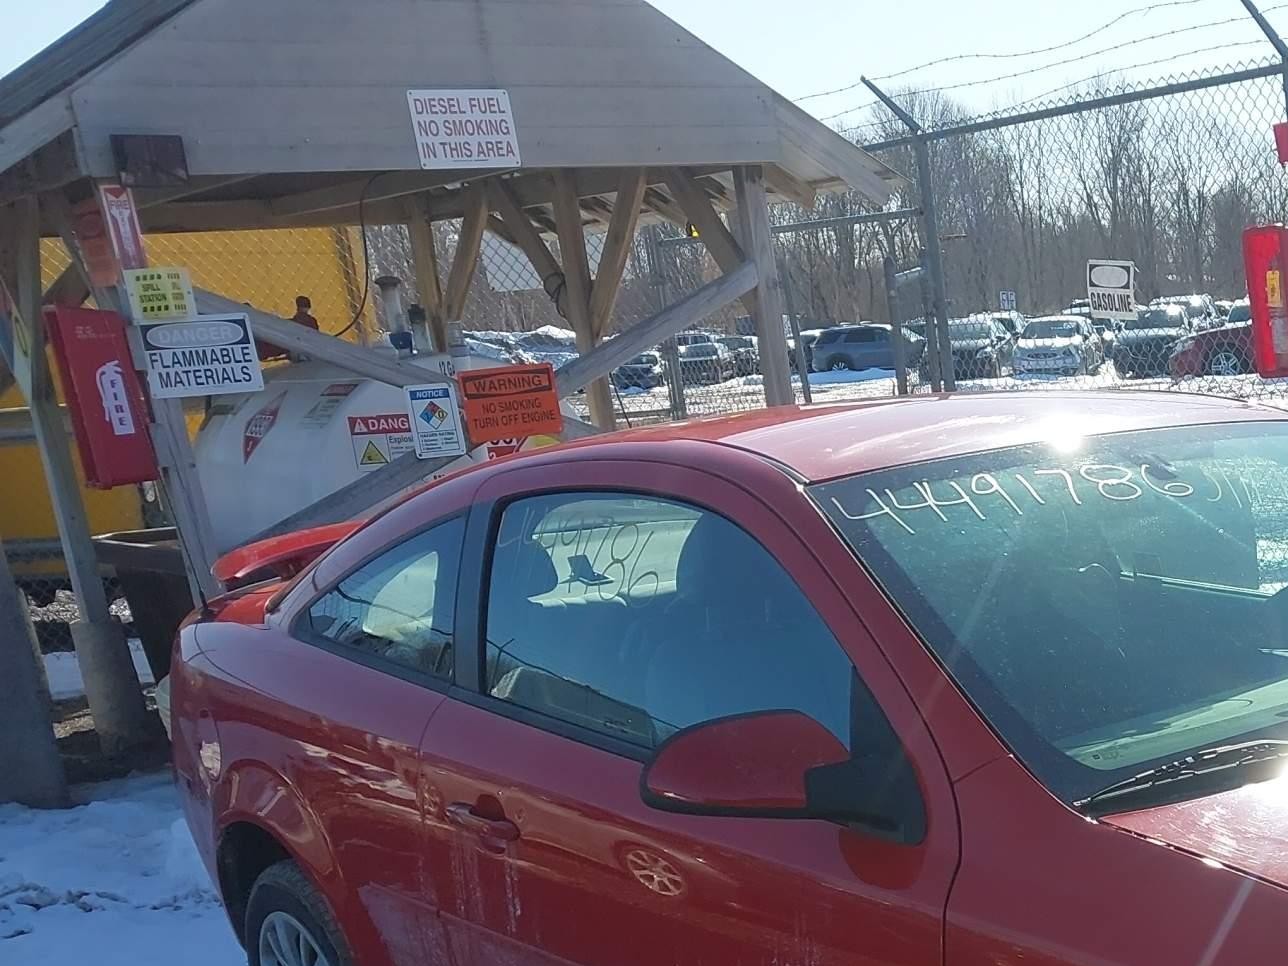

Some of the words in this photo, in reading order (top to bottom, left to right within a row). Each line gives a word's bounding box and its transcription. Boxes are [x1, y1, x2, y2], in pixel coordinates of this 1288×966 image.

[413, 97, 466, 115] DIESEL
[468, 97, 506, 114] FUEL
[417, 120, 440, 137] NO
[442, 119, 511, 137] SMOKING
[421, 142, 438, 159] IN
[438, 141, 473, 158] THIS
[477, 140, 515, 158] AREA
[142, 283, 161, 293] SPILL
[138, 293, 168, 304] STATION
[1090, 291, 1134, 313] GASOLINE
[159, 325, 234, 345] DANGER
[149, 346, 253, 370] FLAMMABLE
[158, 366, 252, 389] MATERIALS
[473, 375, 543, 394] WARNING
[109, 379, 127, 427] FIRE
[416, 389, 444, 399] NOTICE
[482, 402, 498, 414] NO
[499, 397, 542, 413] SMOKING
[368, 417, 409, 431] DANG
[474, 415, 500, 430] TURN
[501, 413, 521, 427] OFF
[521, 410, 556, 425] ENGINE
[388, 436, 414, 445] Explosi
[831, 464, 1193, 535] 44491786
